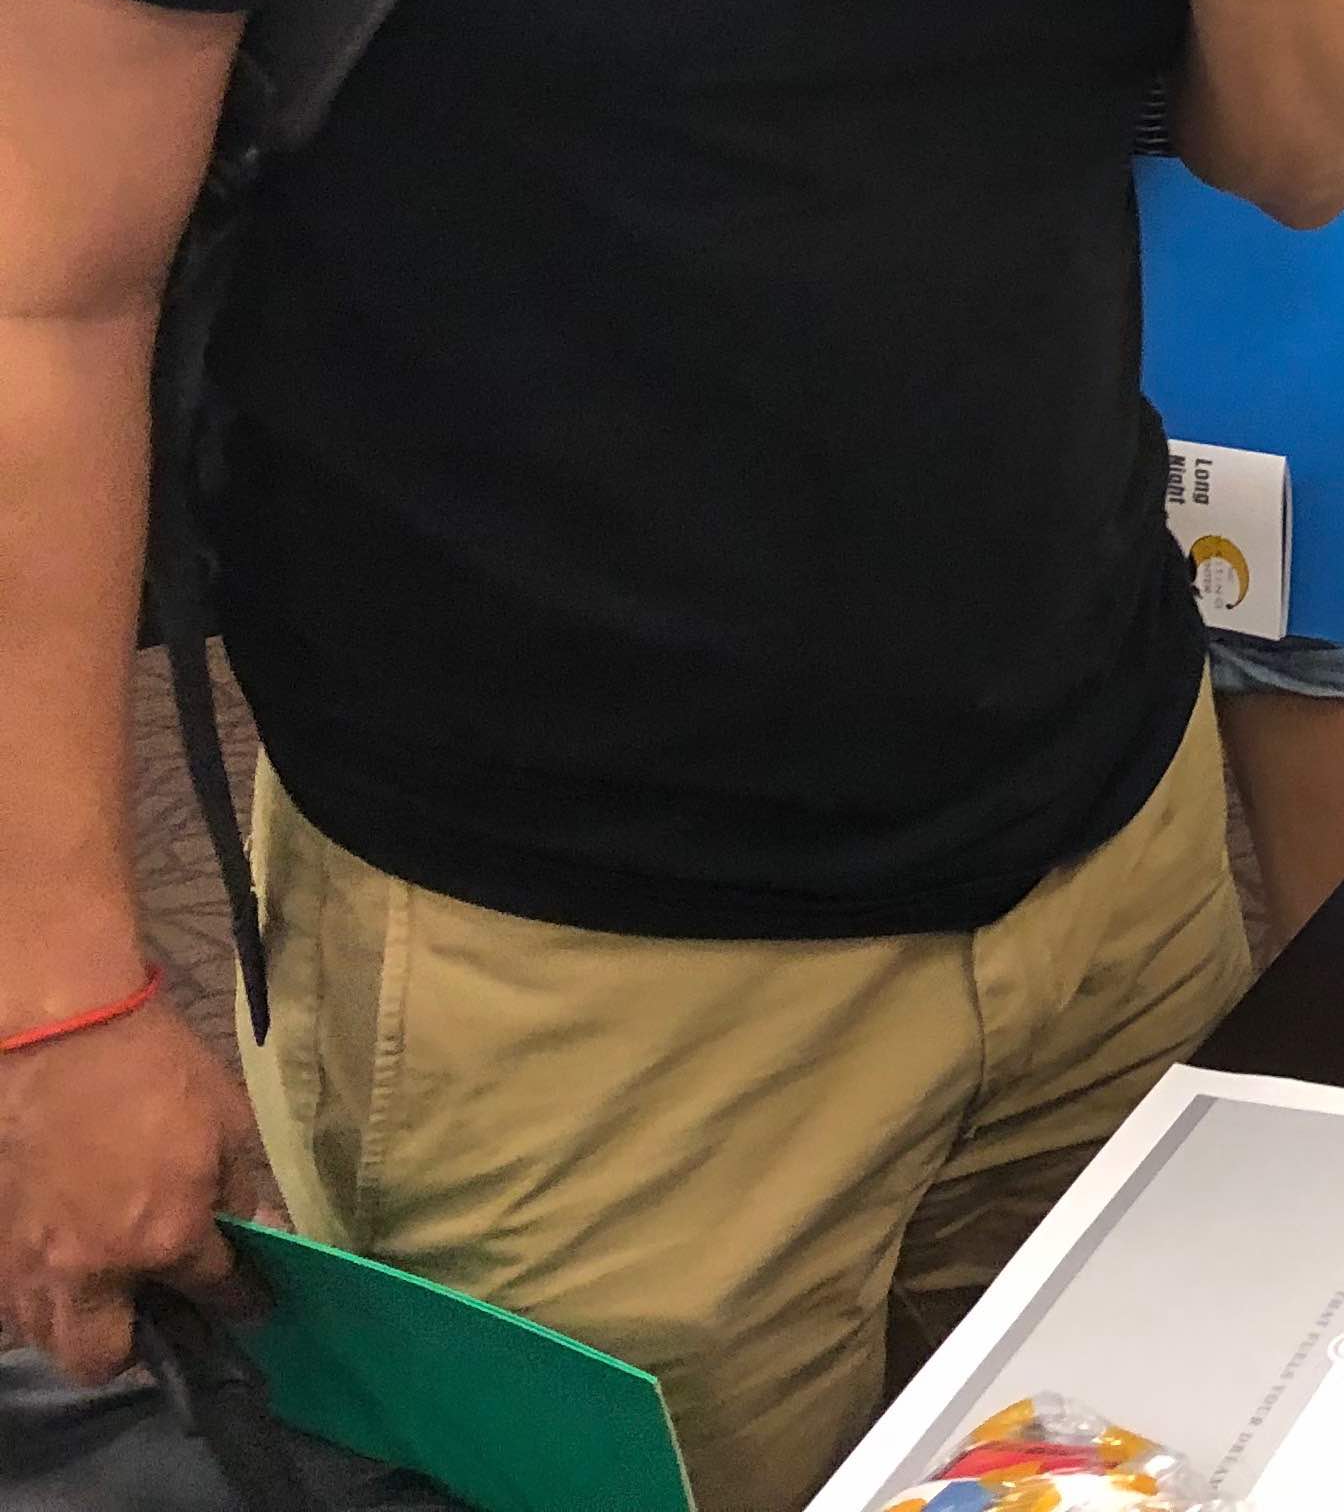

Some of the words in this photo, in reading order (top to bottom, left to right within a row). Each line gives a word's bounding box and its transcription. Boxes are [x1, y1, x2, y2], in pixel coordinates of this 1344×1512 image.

[1193, 458, 1213, 505] Long
[1280, 1331, 1321, 1380] FUELS
[1249, 1384, 1287, 1428] YOUR
